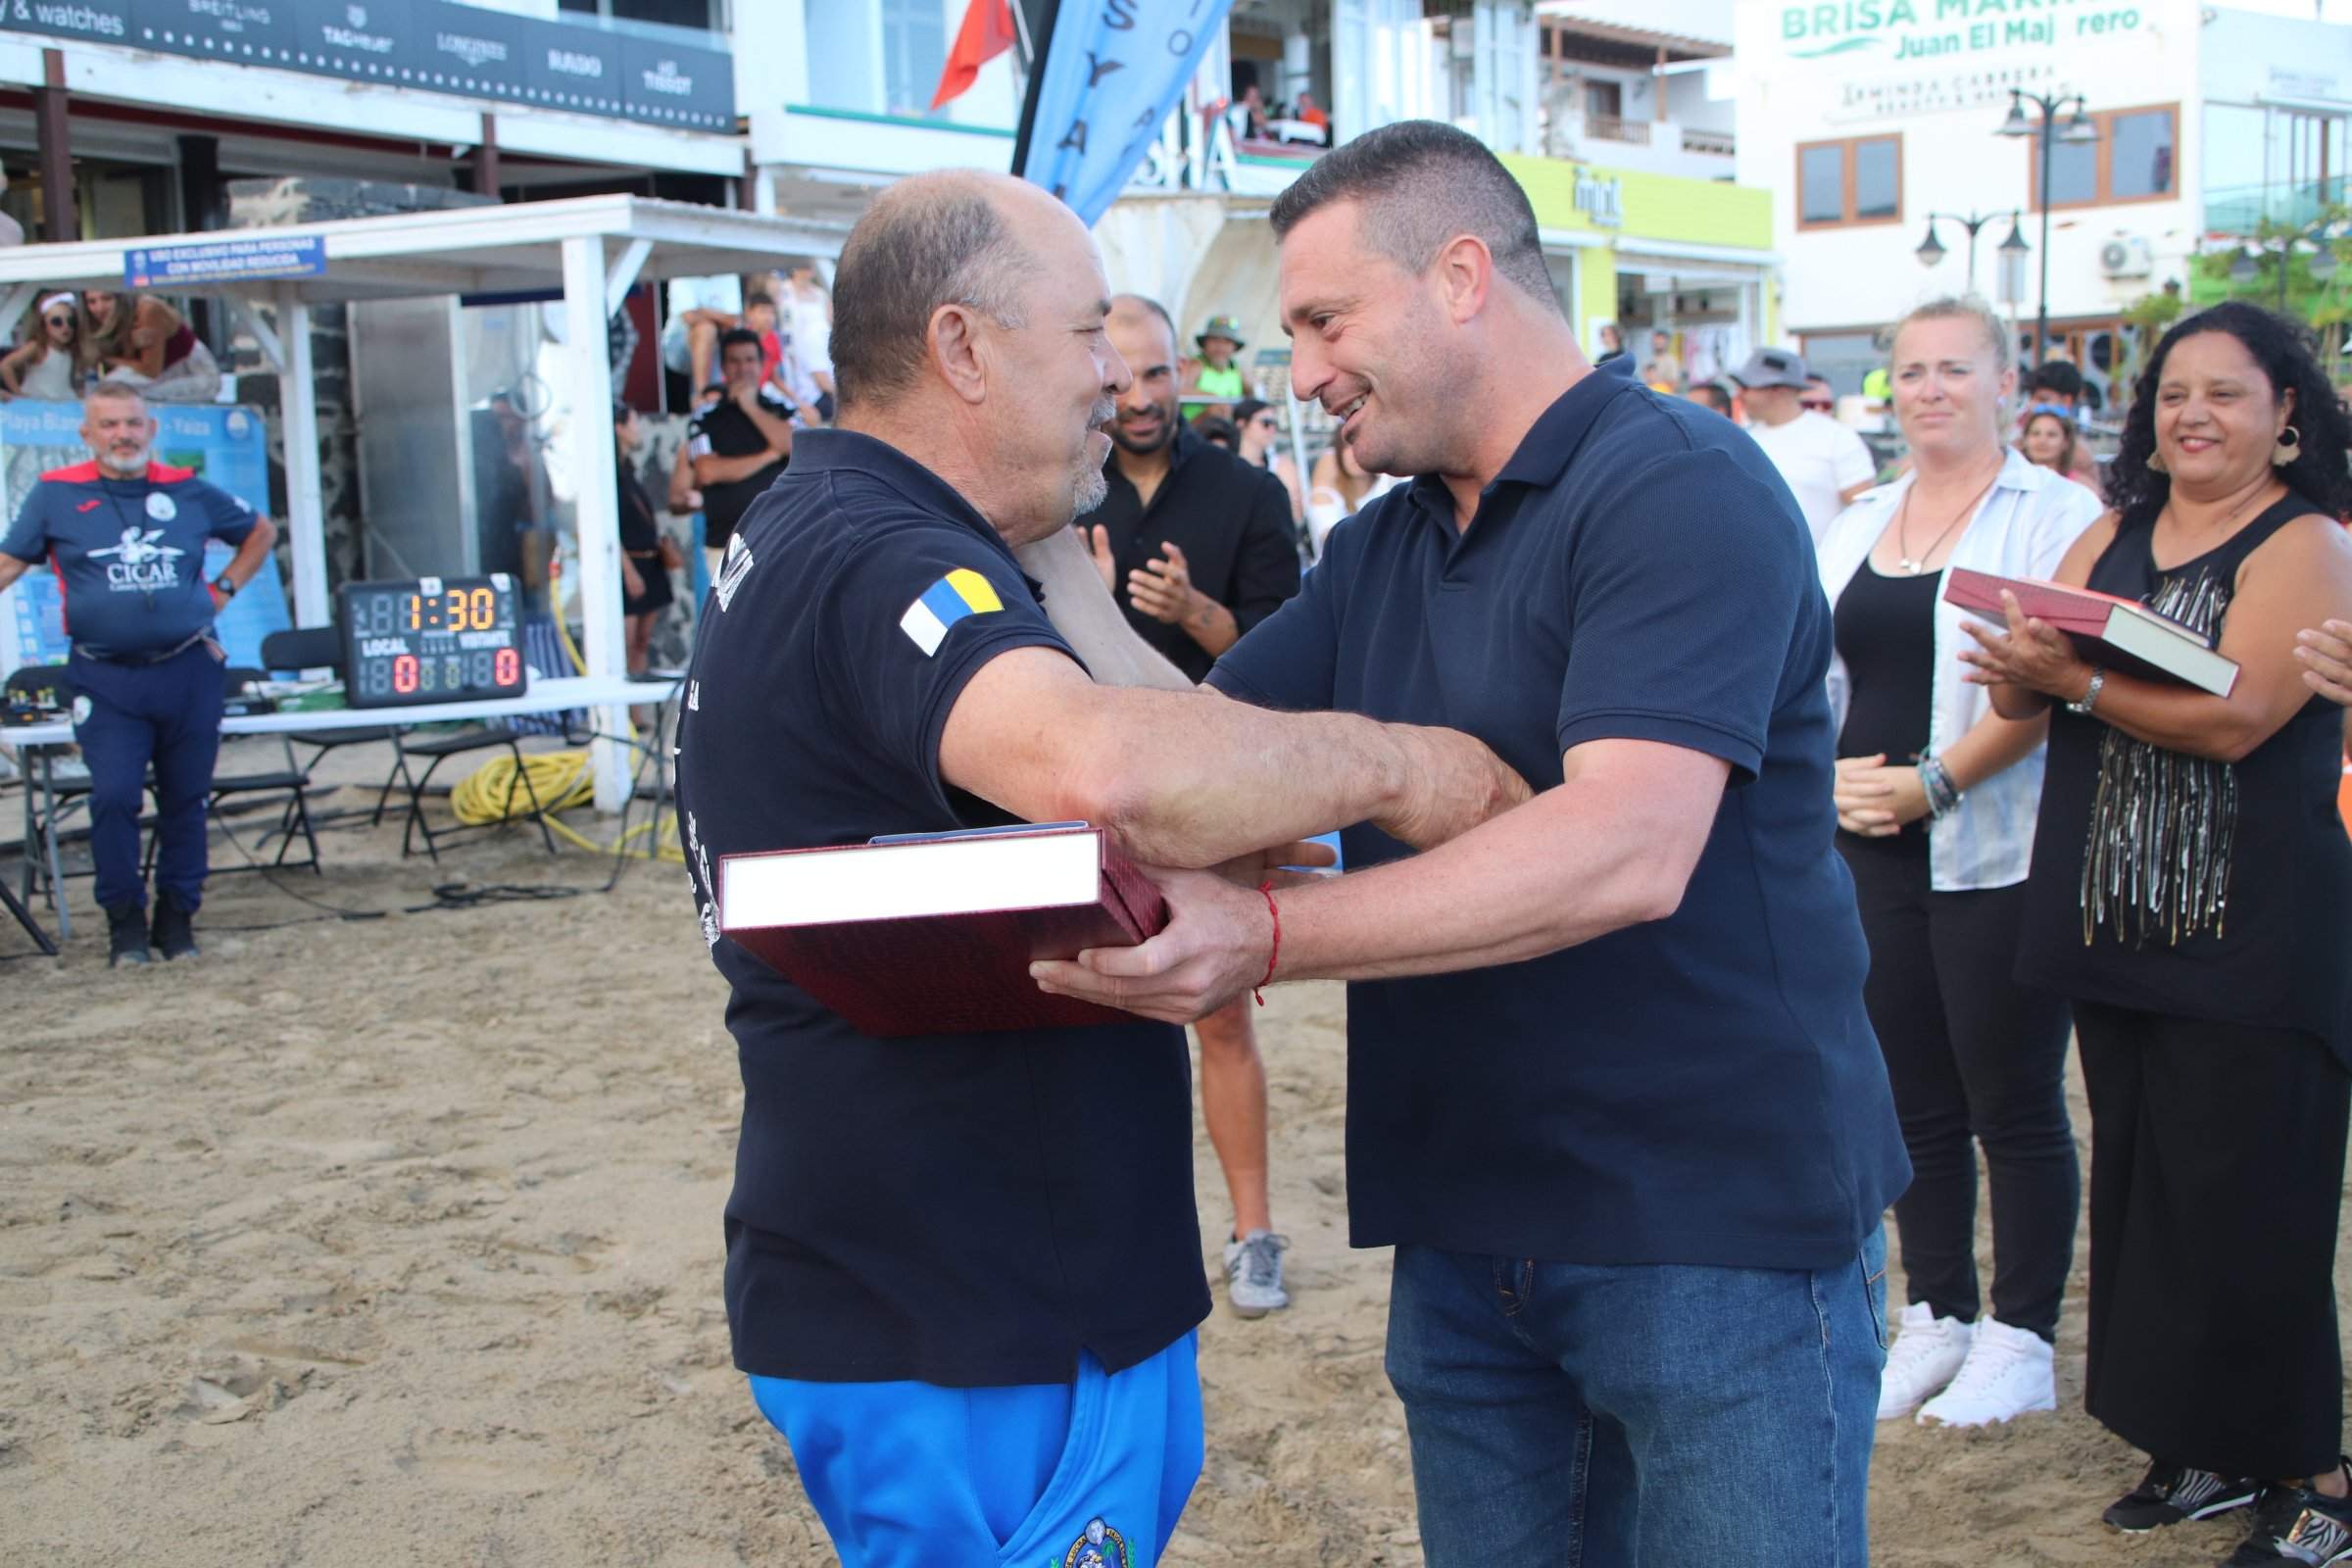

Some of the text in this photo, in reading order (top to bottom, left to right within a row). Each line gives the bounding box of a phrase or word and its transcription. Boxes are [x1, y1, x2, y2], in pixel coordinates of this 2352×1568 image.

[36, 4, 125, 36] watches
[1782, 0, 1918, 40] BRISA
[1893, 32, 1960, 61] Juan
[1969, 22, 1995, 50] El
[107, 562, 179, 585] CICAR
[411, 588, 494, 632] 1:30
[362, 638, 410, 658] LOCAL
[394, 649, 519, 694] 0 0
